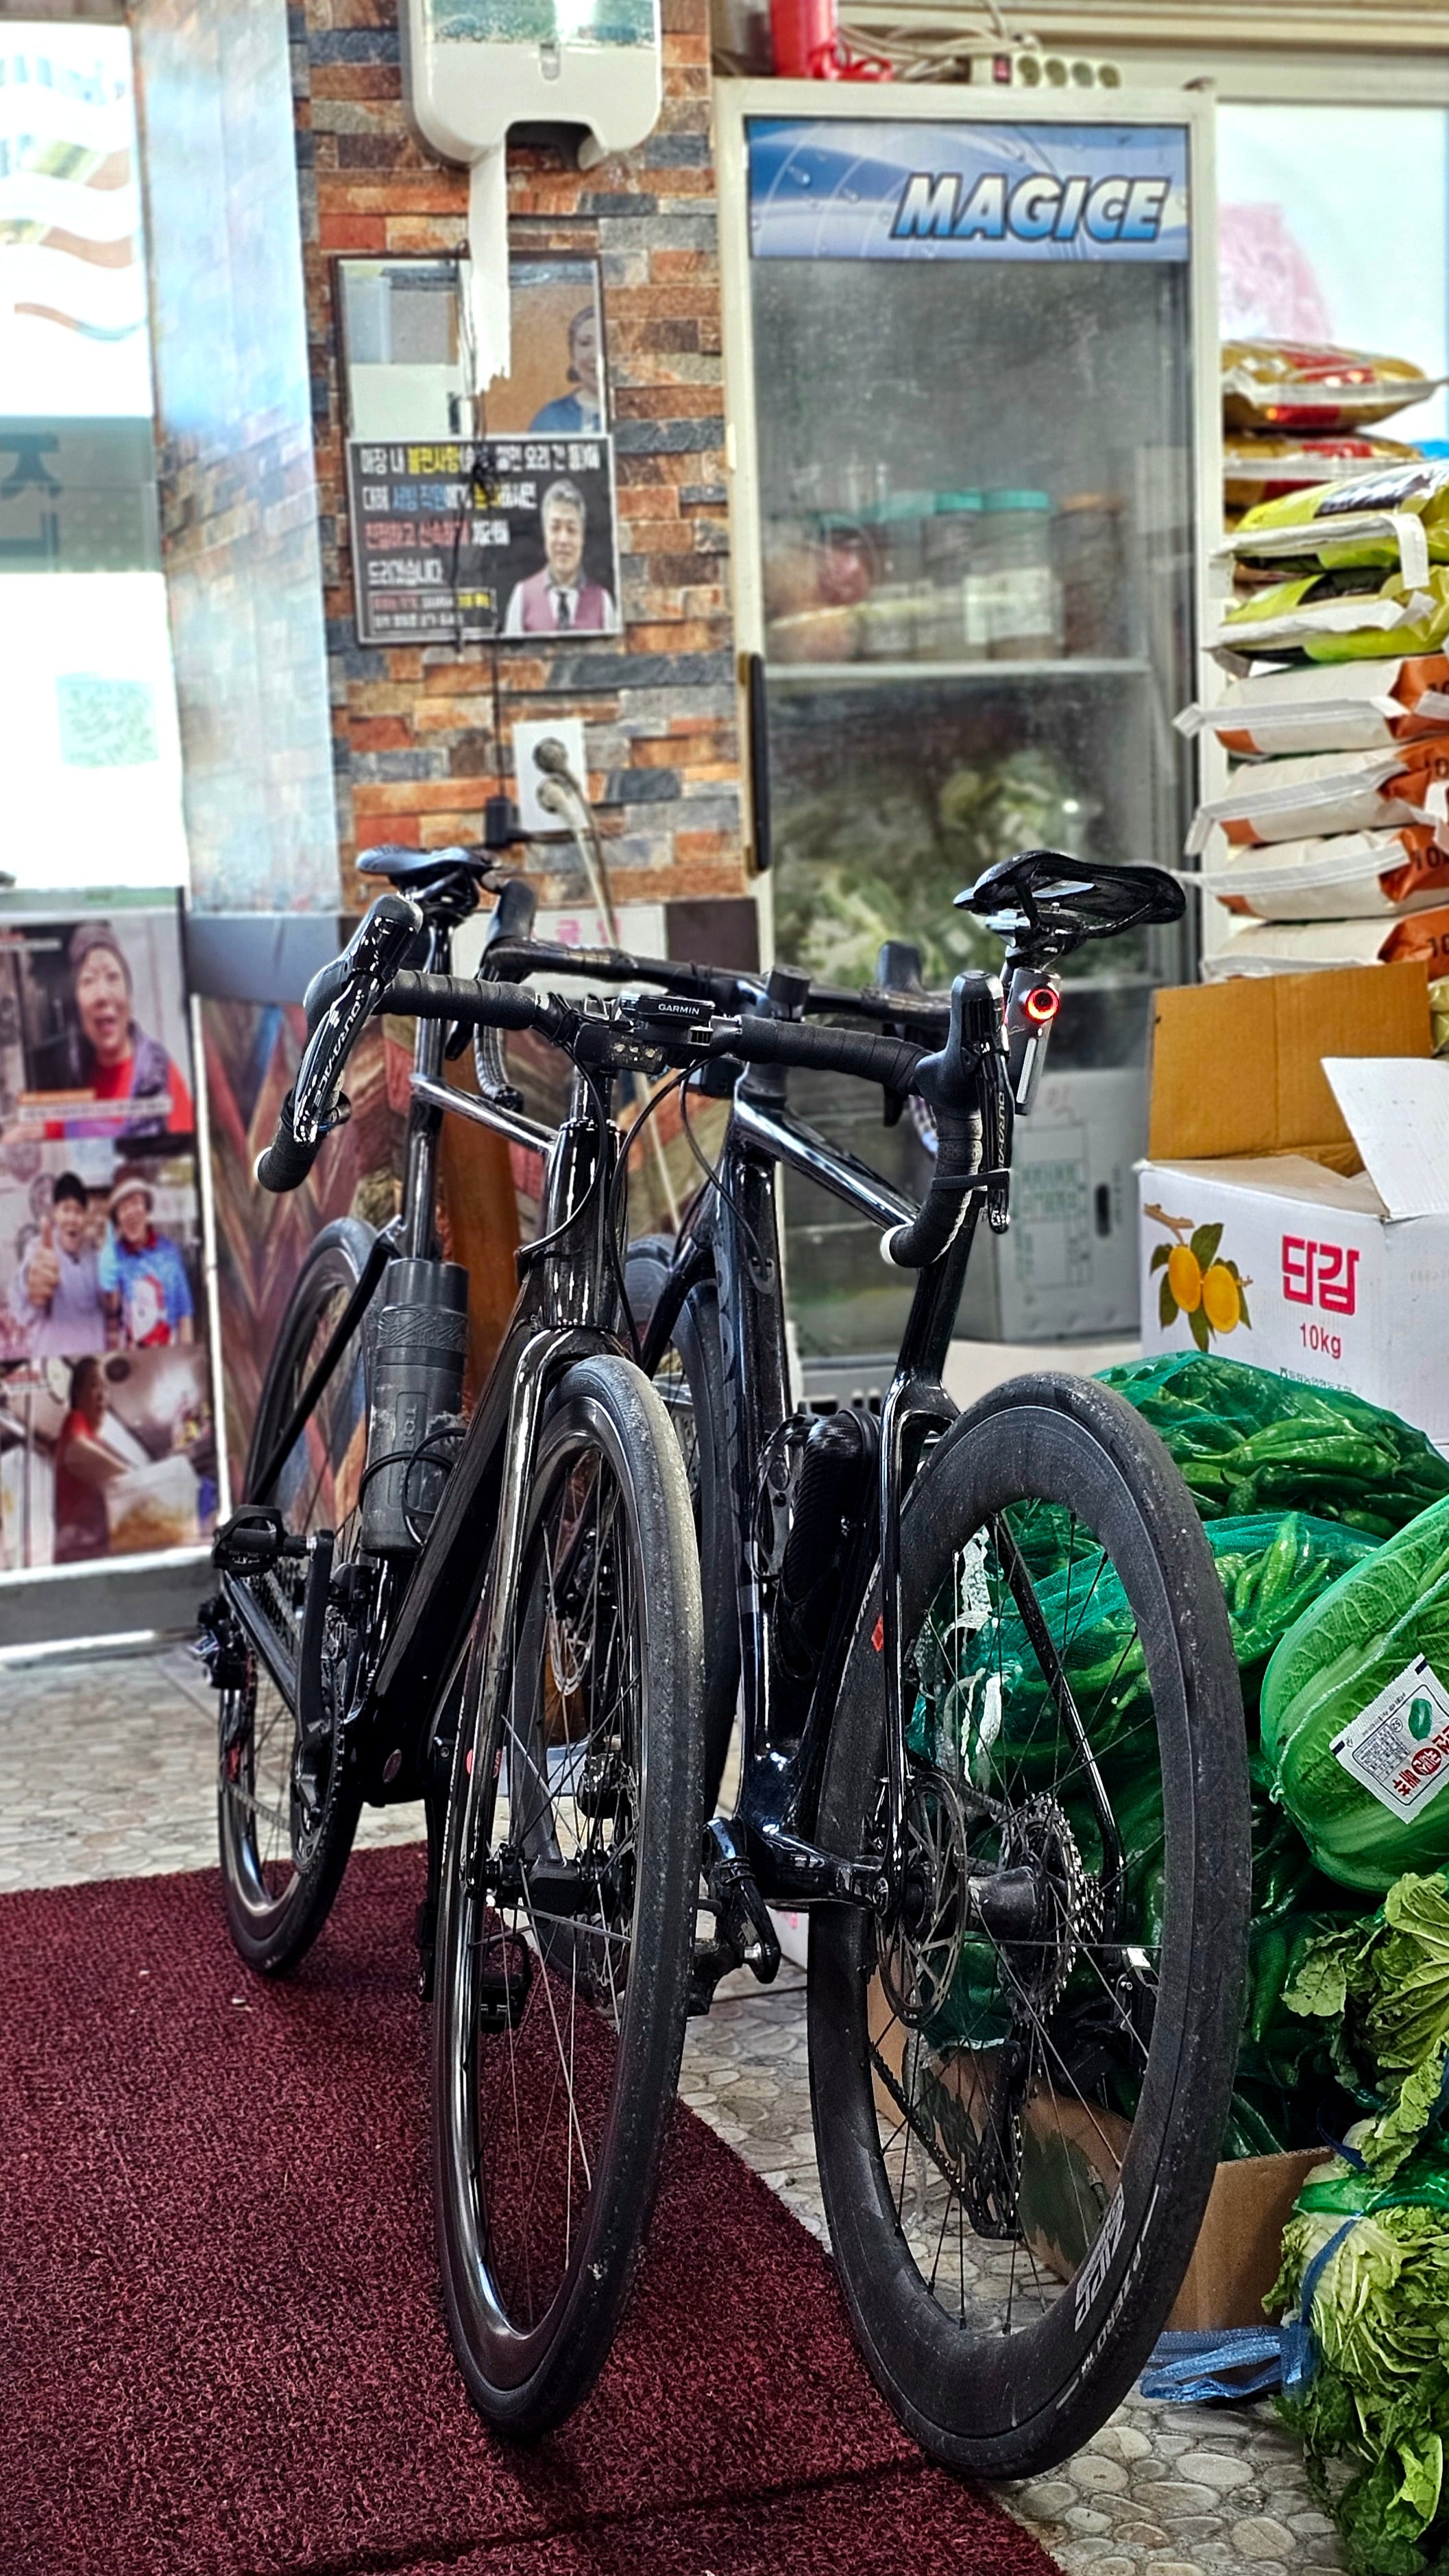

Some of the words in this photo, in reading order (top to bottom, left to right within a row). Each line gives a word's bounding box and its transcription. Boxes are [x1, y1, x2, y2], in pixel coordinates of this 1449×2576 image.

[890, 173, 1171, 243] MAGICE
[658, 1003, 699, 1015] GARMIN
[313, 1000, 361, 1107] DURA-ACE
[1282, 1235, 1360, 1316] 단감
[1300, 1323, 1341, 1360] 10kg
[1392, 1769, 1422, 1796] 배추
